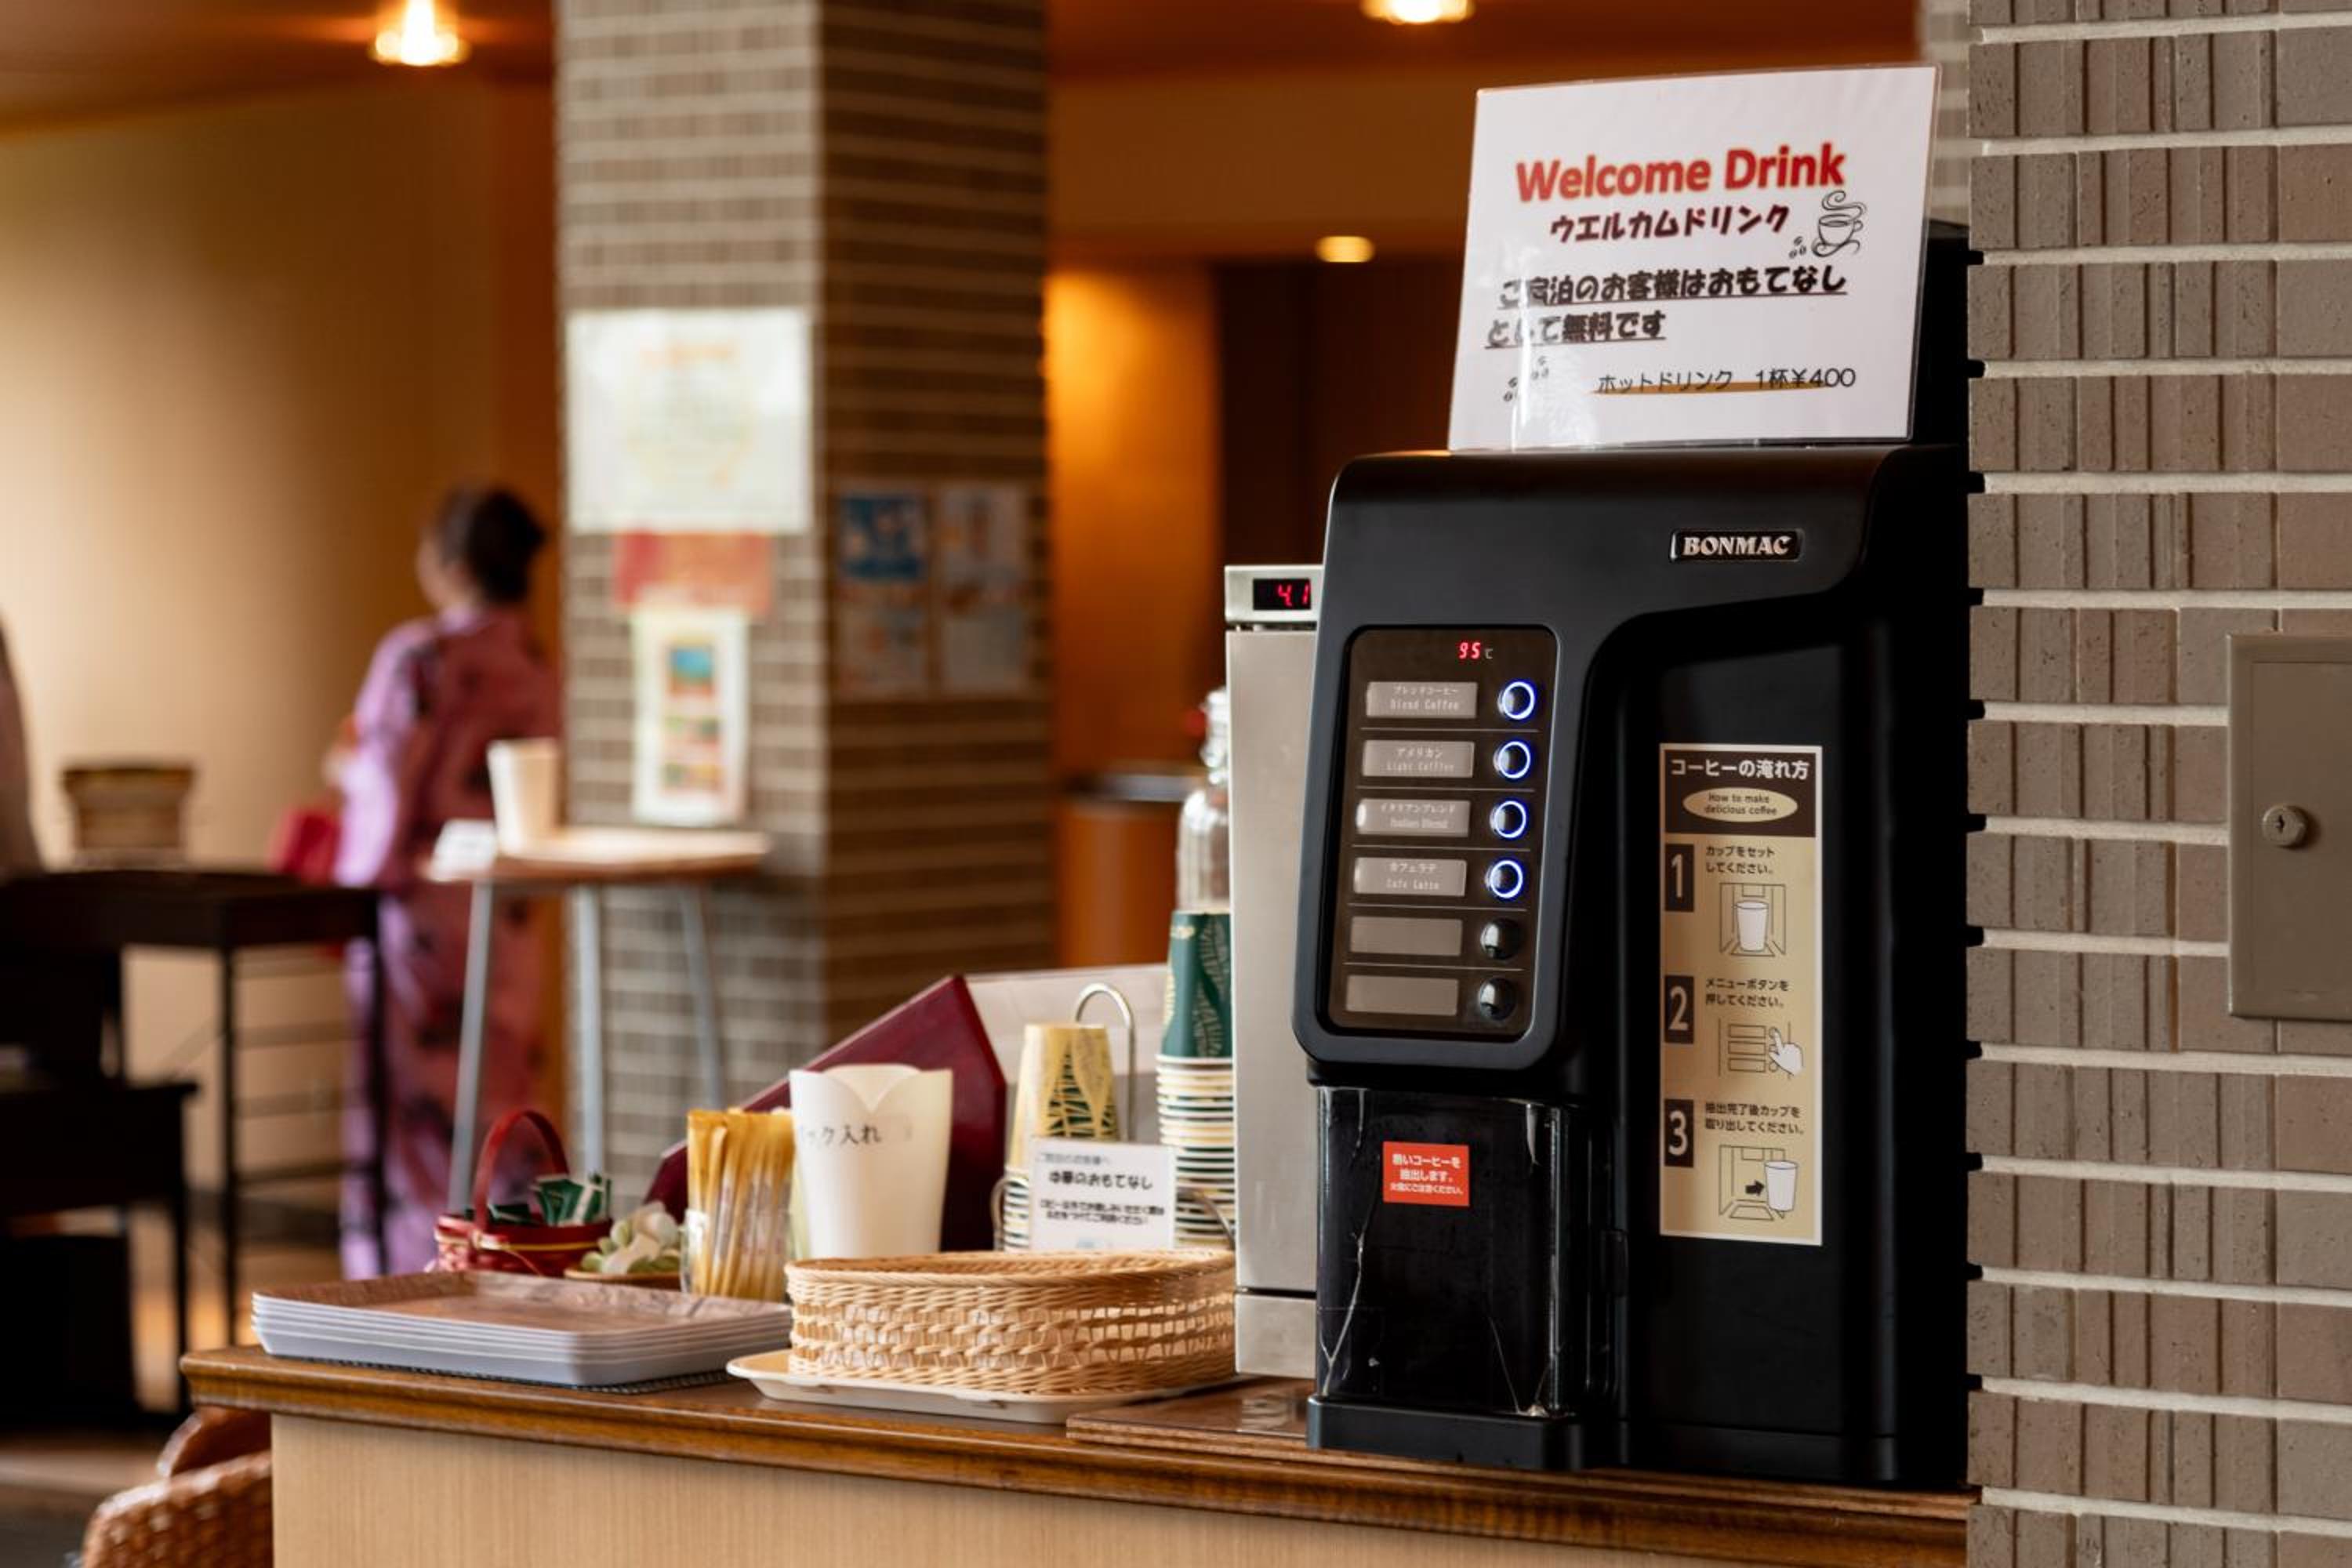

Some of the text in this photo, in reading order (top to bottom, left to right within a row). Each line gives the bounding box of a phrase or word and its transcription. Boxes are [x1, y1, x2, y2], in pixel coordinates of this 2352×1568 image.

[1516, 142, 1846, 202] Welcome Drink
[1550, 204, 1790, 243] ウエルカムドリンク
[1599, 370, 1733, 393] ホットドリンク
[1682, 535, 1792, 556] BONMAC
[1671, 759, 1809, 780] コーヒーの淹れ方
[1708, 793, 1769, 804] How to make
[1704, 804, 1777, 815] delicious coffee
[1706, 846, 1775, 858] カップをセット
[1671, 854, 1683, 898] 1
[1706, 863, 1773, 874] してください。
[1706, 978, 1788, 992] メニューボタンを
[1668, 985, 1689, 1031] 2
[1668, 1109, 1689, 1156] 3
